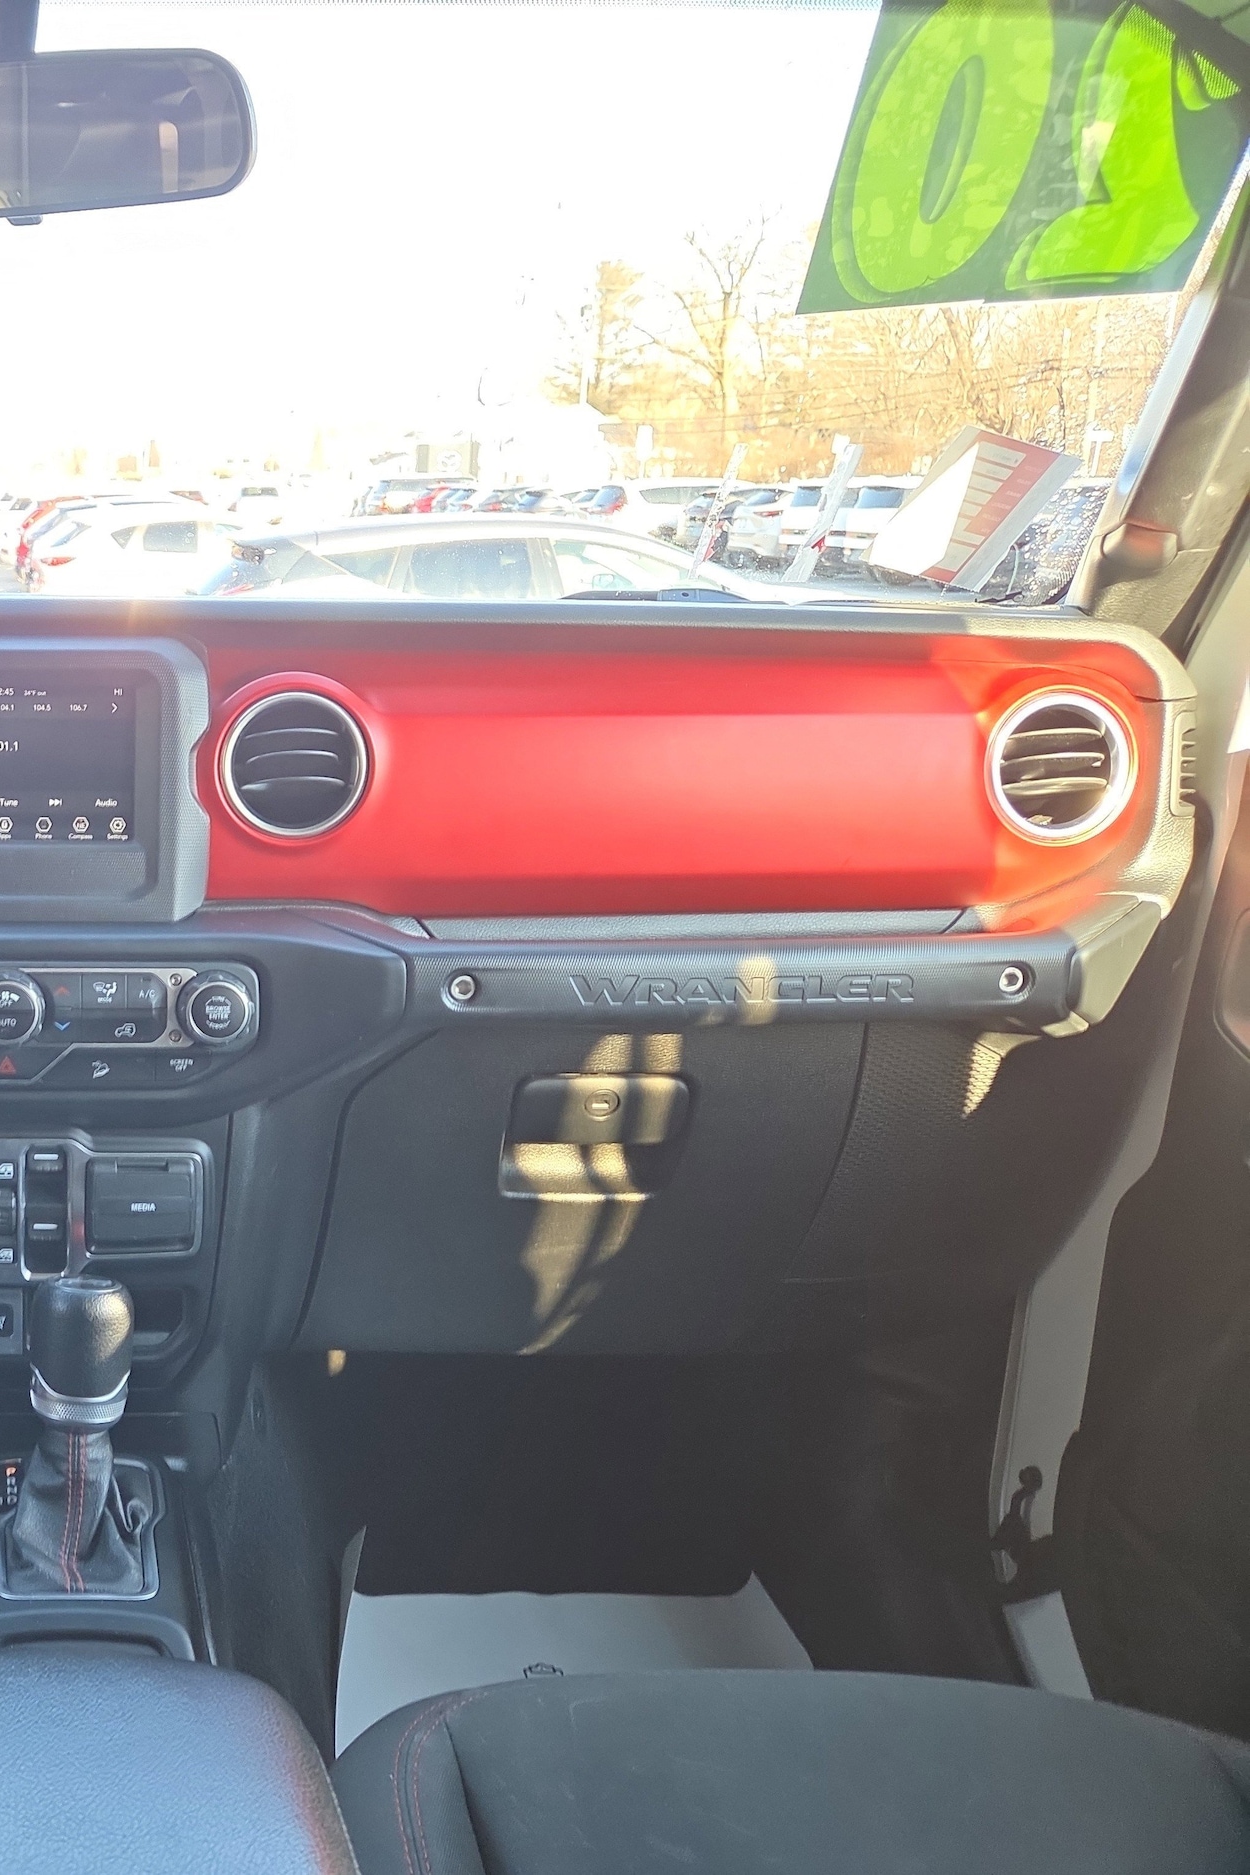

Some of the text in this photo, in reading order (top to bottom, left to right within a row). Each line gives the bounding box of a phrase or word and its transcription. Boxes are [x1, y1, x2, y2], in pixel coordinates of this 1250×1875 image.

[113, 688, 123, 696] HI
[69, 704, 88, 712] 106.7
[0, 798, 19, 807] Tune
[95, 798, 118, 807] Audio
[139, 989, 156, 998] A/C
[569, 973, 915, 1006] WRANGLER
[131, 1203, 156, 1212] MEDIA
[7, 1485, 18, 1495] N
